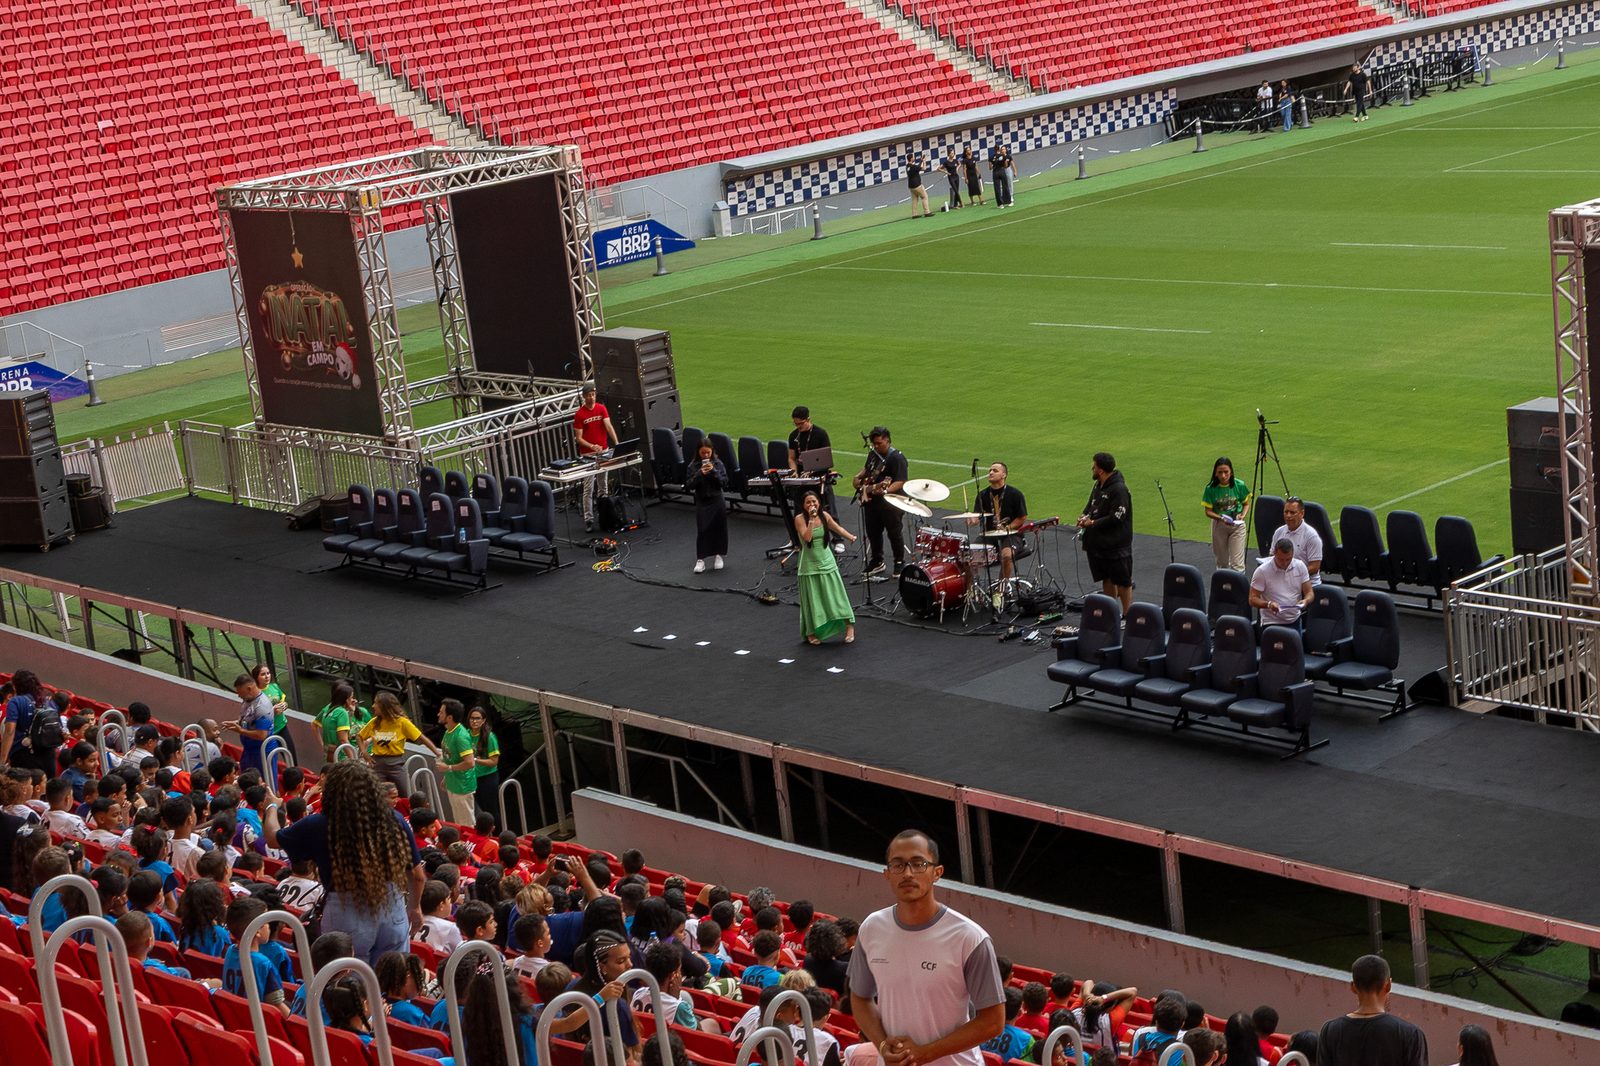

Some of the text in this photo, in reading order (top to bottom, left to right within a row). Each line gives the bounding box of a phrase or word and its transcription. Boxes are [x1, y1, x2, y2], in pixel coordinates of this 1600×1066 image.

[622, 224, 649, 237] ARENA
[622, 232, 651, 256] BRB
[267, 291, 358, 349] NATAL
[311, 341, 325, 353] EM
[307, 352, 334, 367] CAMPO
[921, 961, 937, 971] CCF
